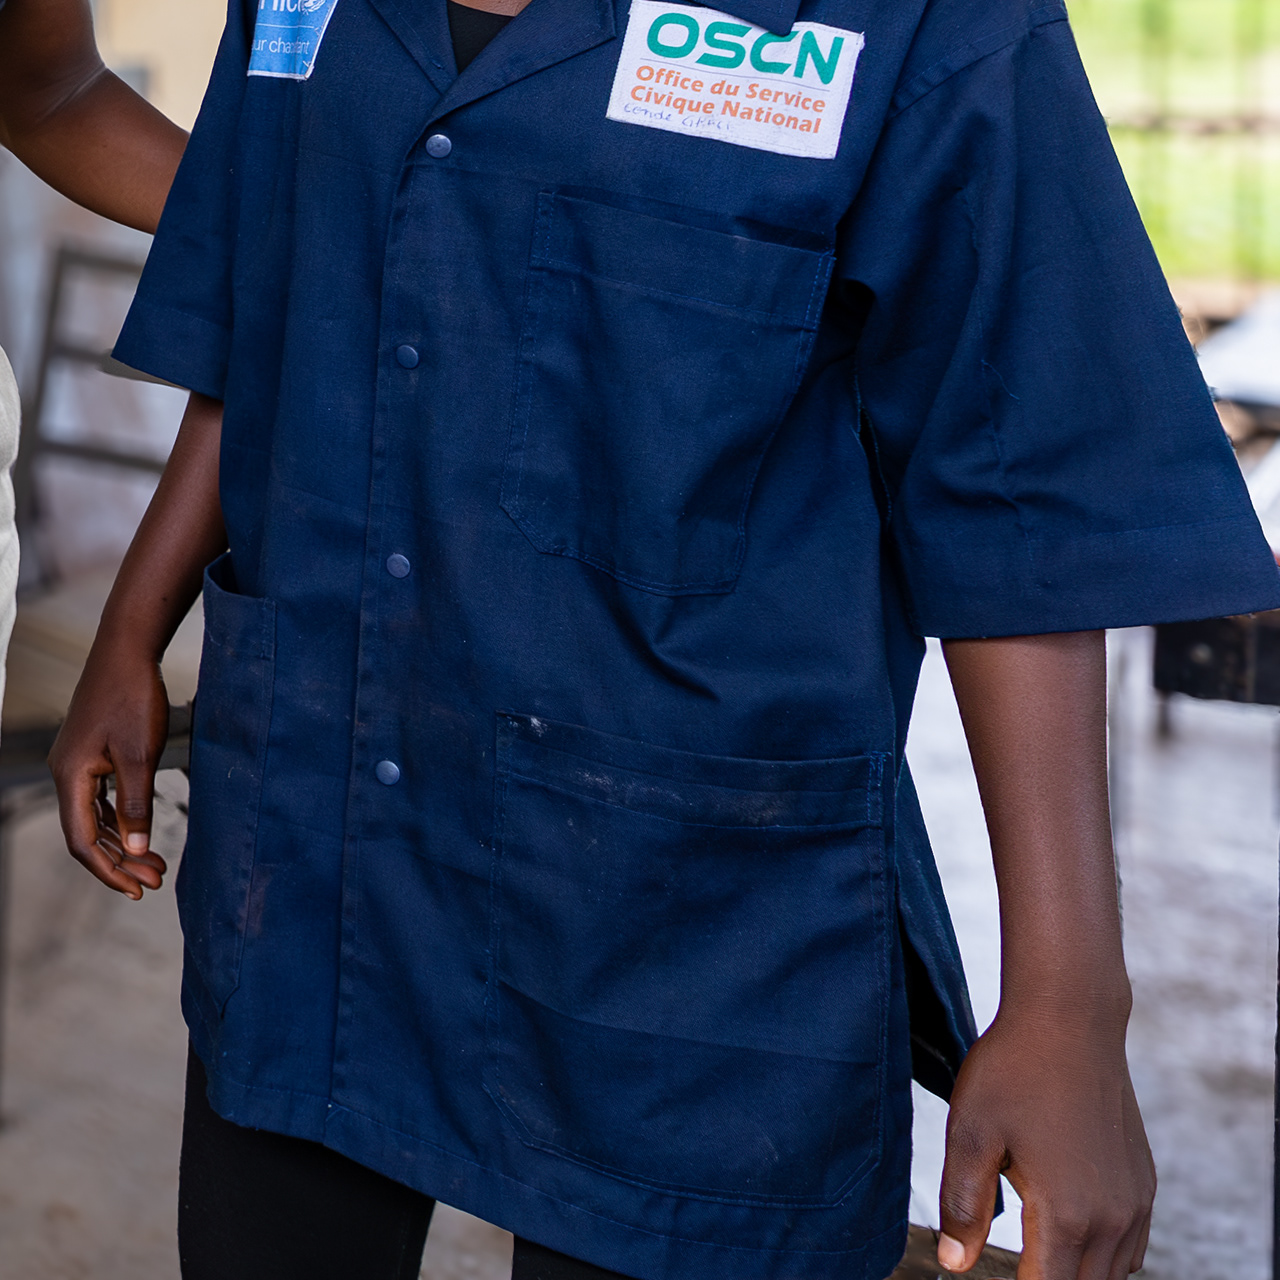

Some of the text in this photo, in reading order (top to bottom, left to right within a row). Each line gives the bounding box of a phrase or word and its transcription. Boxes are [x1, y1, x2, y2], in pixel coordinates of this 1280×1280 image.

[646, 12, 844, 85] OSCN
[630, 85, 822, 134] Civique National
[636, 65, 826, 113] Office du Service
